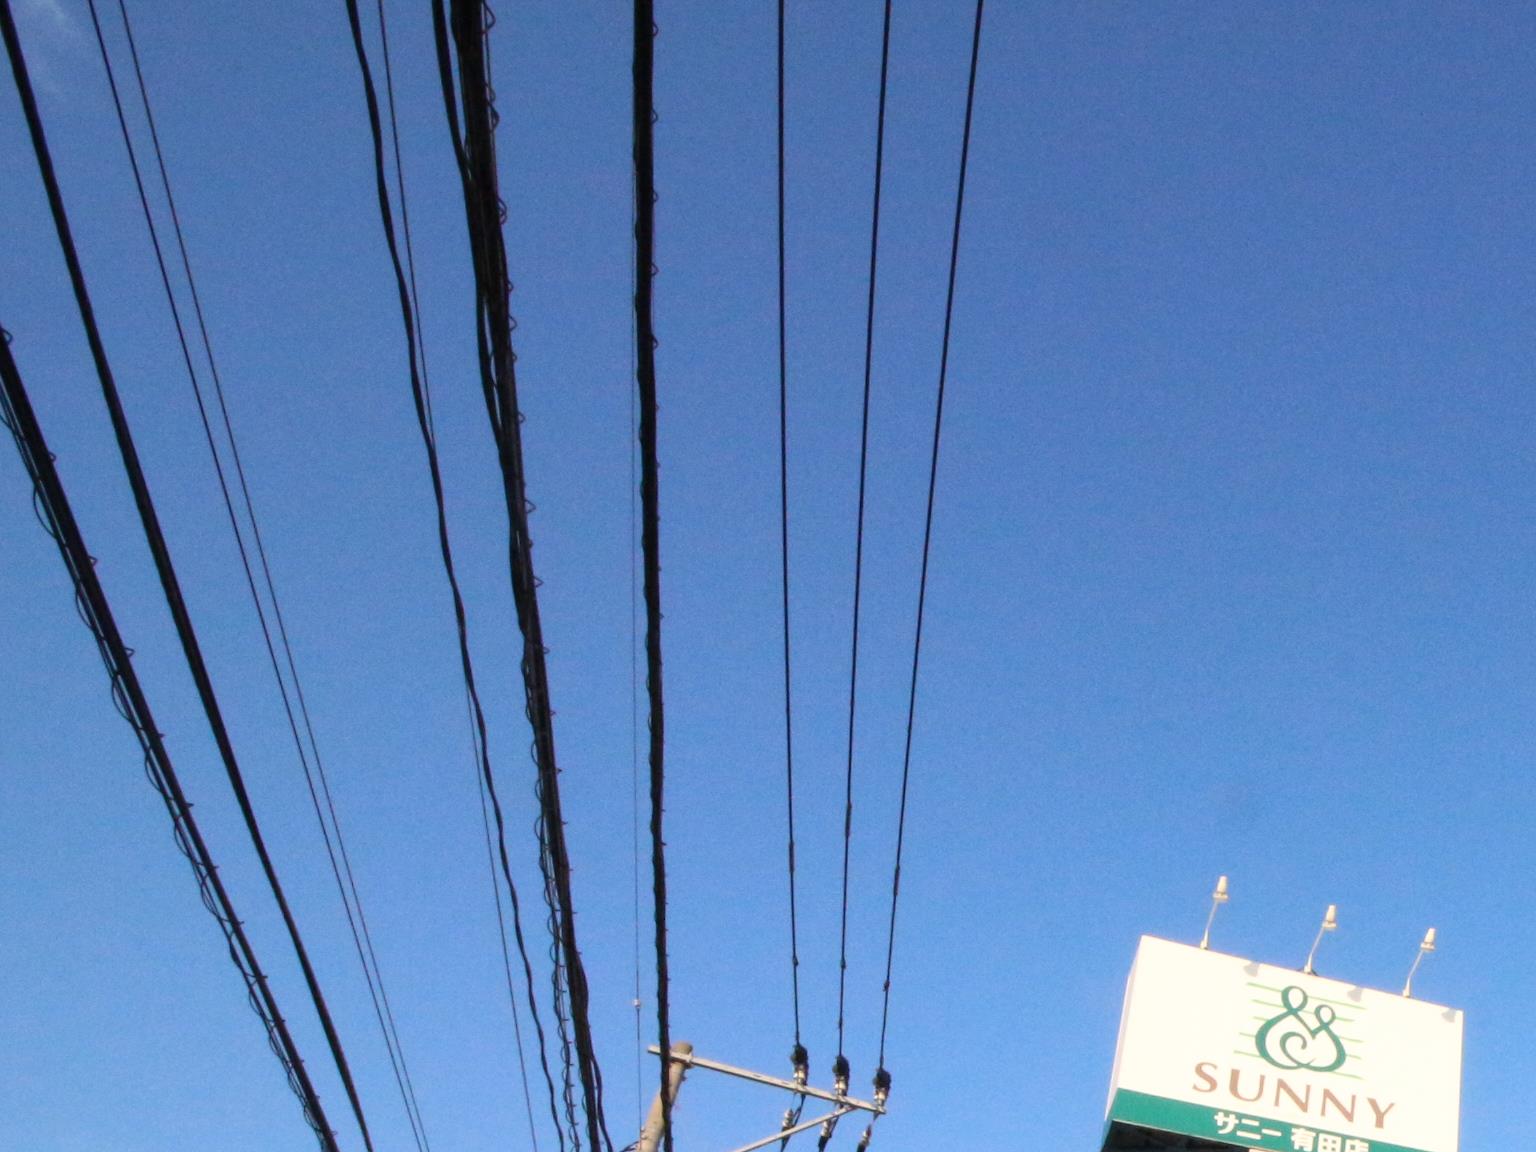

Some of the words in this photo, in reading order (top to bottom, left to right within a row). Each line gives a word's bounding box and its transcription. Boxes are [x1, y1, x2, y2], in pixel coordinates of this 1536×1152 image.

[1192, 1061, 1396, 1129] SUNNY
[1213, 1111, 1282, 1140] サニー
